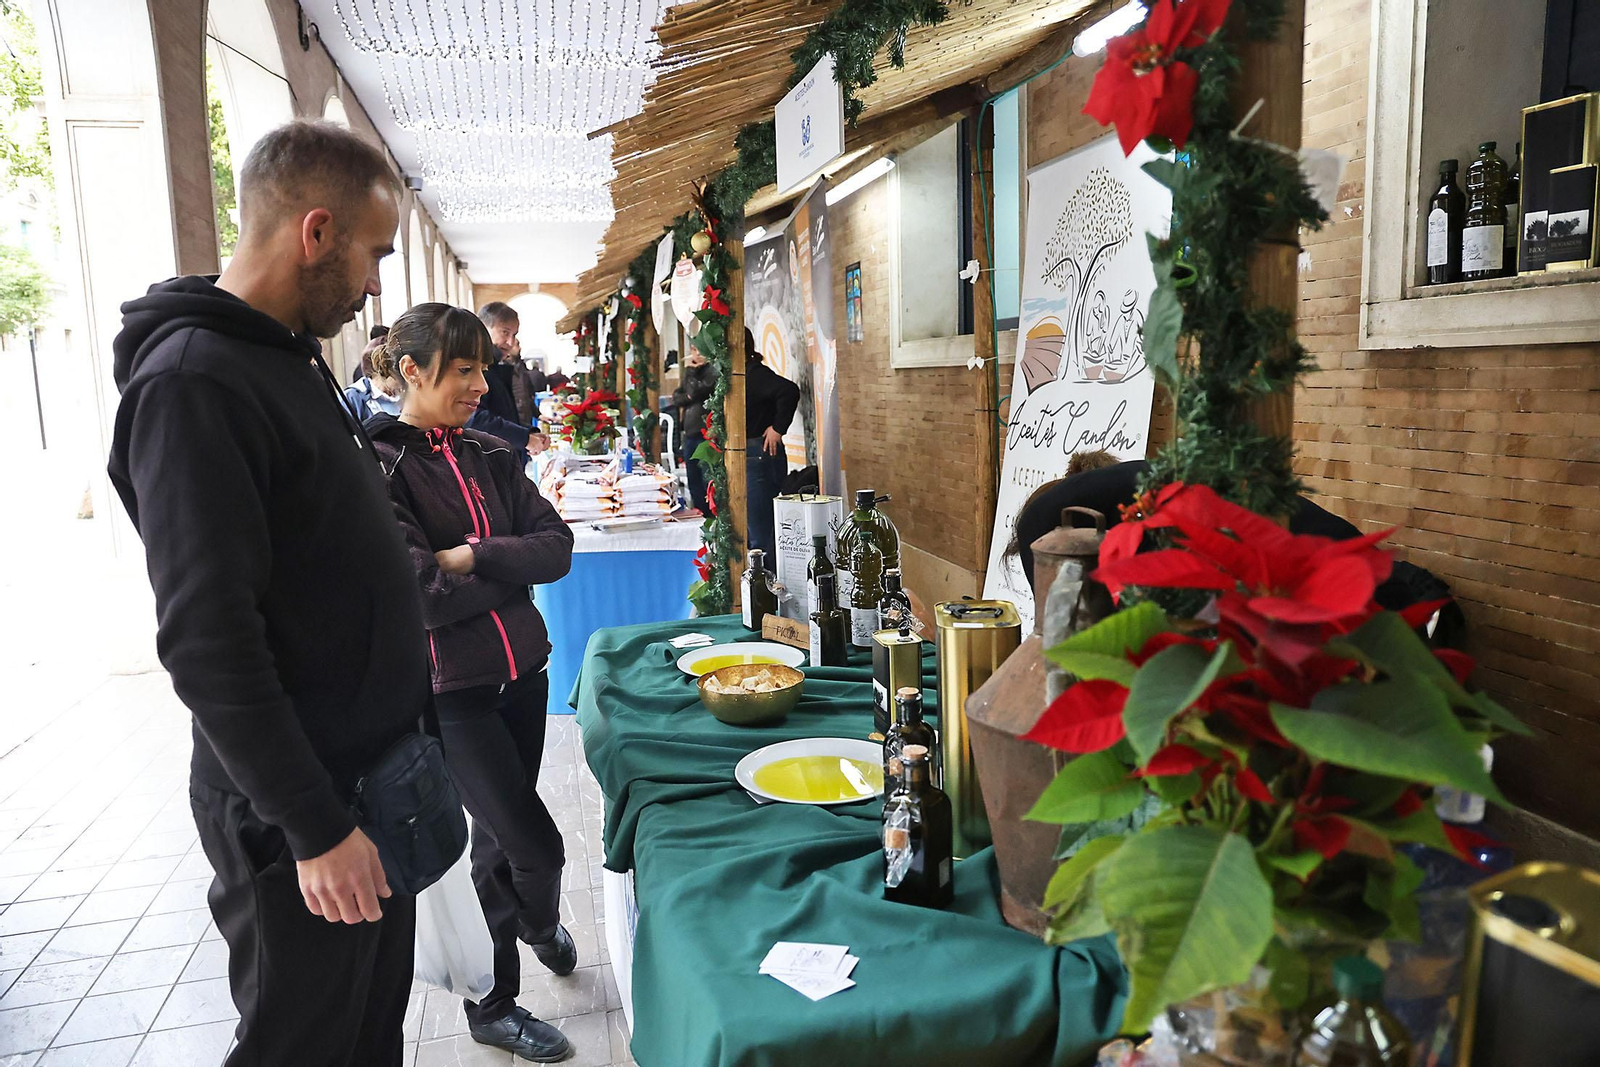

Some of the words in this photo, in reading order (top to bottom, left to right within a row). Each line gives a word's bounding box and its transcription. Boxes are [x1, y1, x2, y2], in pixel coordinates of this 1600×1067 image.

[1007, 399, 1057, 451] Aceites
[1050, 400, 1136, 455] Candón
[1012, 466, 1045, 488] ACEITE
